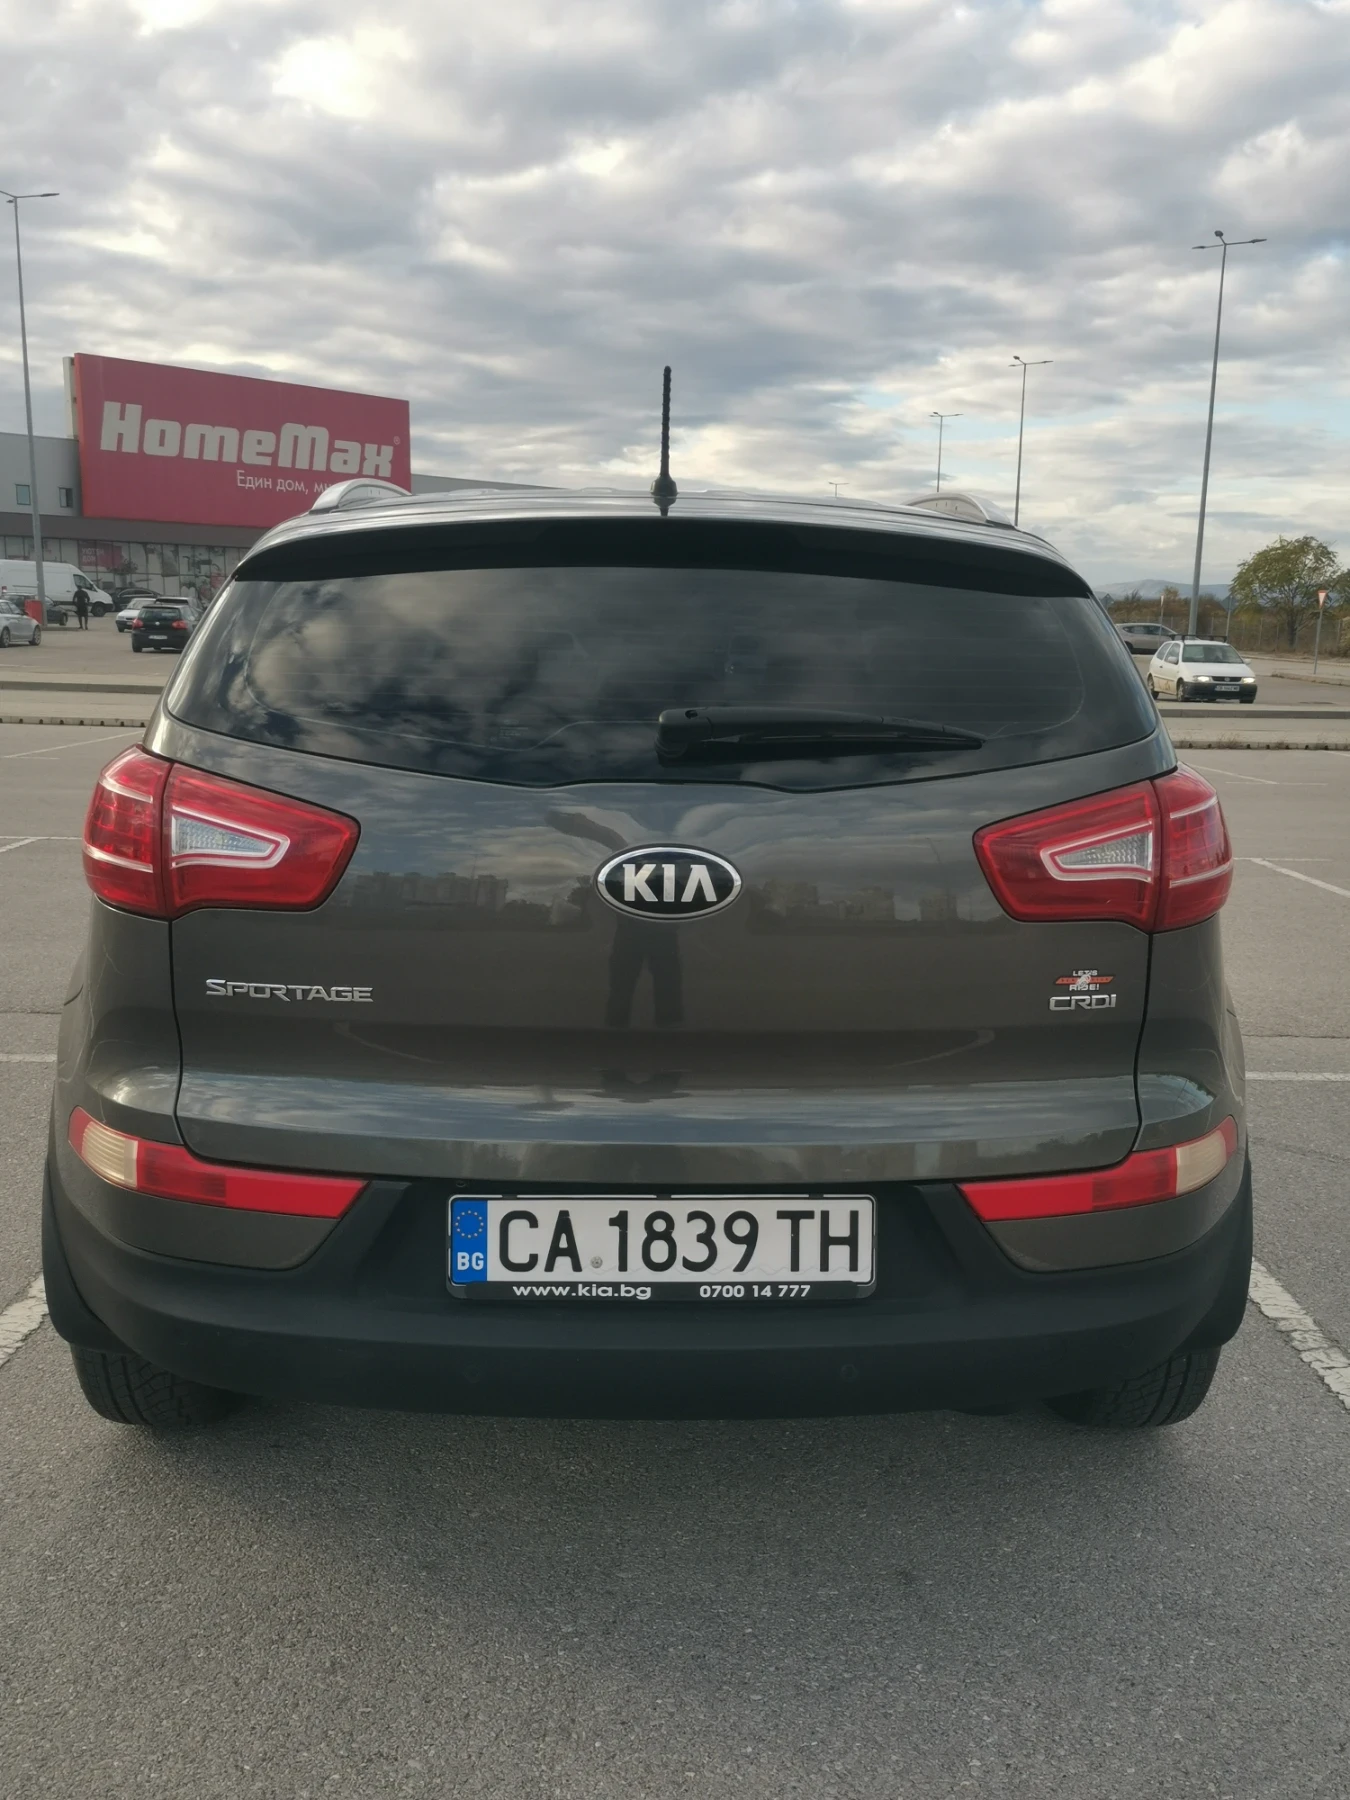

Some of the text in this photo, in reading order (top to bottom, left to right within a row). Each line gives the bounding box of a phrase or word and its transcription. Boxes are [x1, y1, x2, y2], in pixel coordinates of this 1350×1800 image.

[100, 401, 394, 478] HomeMax
[236, 470, 272, 490] Един
[276, 479, 309, 495] дом,
[622, 863, 718, 903] KIA
[499, 1210, 859, 1273] CA 1839 TH
[457, 1252, 485, 1271] BG
[513, 1284, 811, 1300] www.kia.bg 0700 14 777
